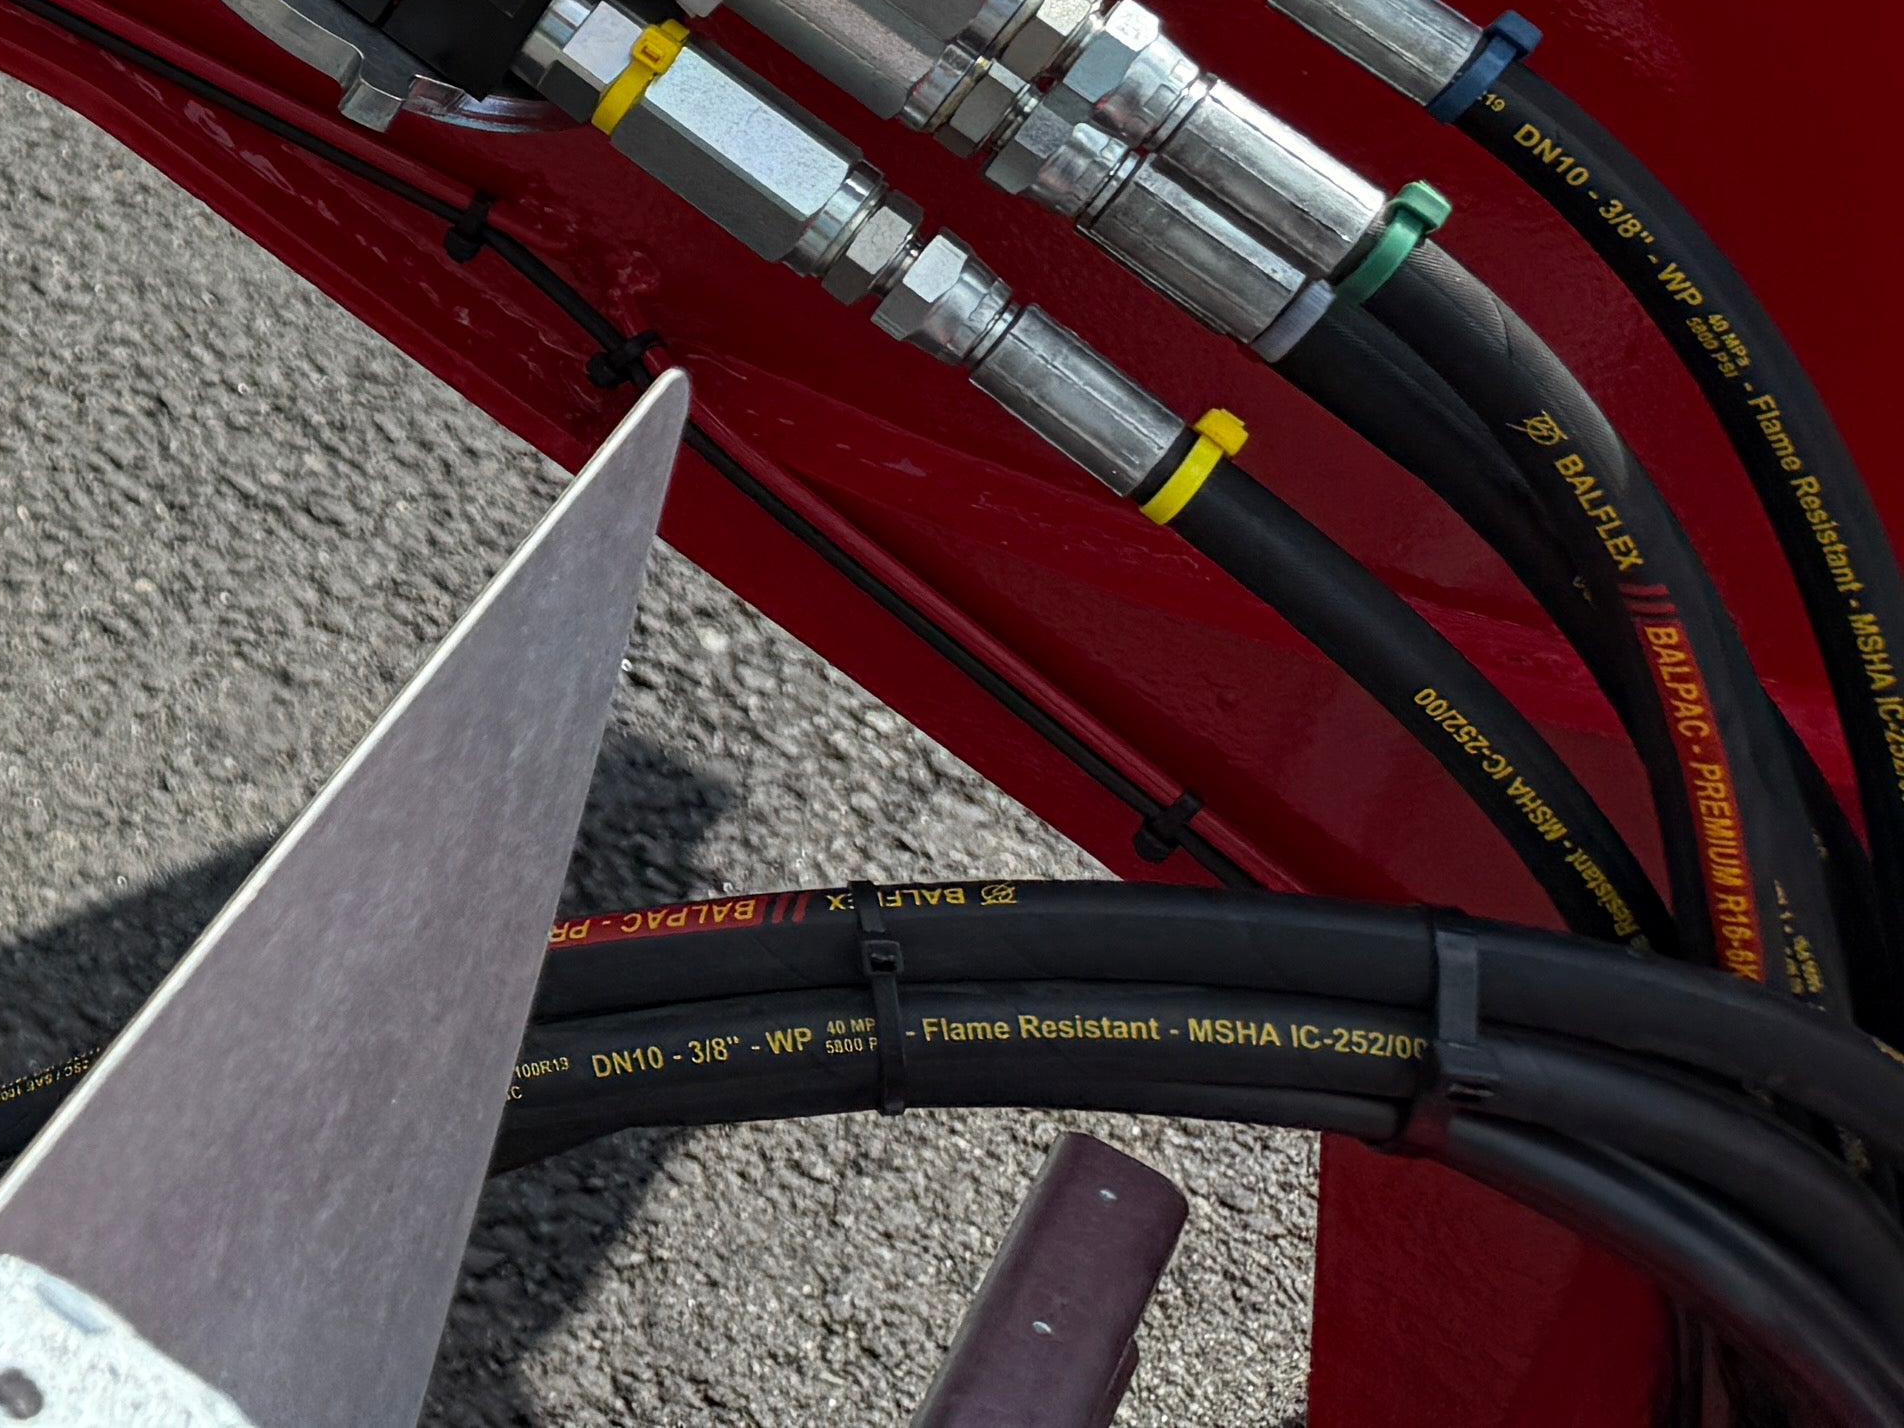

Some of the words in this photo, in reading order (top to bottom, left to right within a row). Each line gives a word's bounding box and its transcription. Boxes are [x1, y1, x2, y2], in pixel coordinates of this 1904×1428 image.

[1513, 122, 1590, 189] DN10
[1597, 198, 1657, 246] 3/8"
[1657, 261, 1704, 308] WP
[1706, 312, 1731, 337] 40
[1746, 392, 1803, 473] Flame
[1788, 472, 1866, 593] Resistant
[1848, 612, 1897, 692] MSHA
[1553, 452, 1645, 572] BALFLEX
[1642, 623, 1711, 742] BALPAC
[1688, 760, 1745, 896] PREMIUM
[1413, 686, 1514, 779] IC-252/00
[1506, 775, 1570, 844] MSHA
[620, 899, 755, 933] BALPAC
[826, 885, 966, 912] BALFEX
[592, 1045, 664, 1079] DN10
[690, 1035, 740, 1065] 3/8"
[764, 1026, 813, 1057] WP
[826, 1019, 845, 1036] 40
[849, 1017, 877, 1035] MP
[922, 1017, 1011, 1043] Flame
[1019, 1015, 1160, 1041] Resistant
[1188, 1018, 1282, 1048] MSHA
